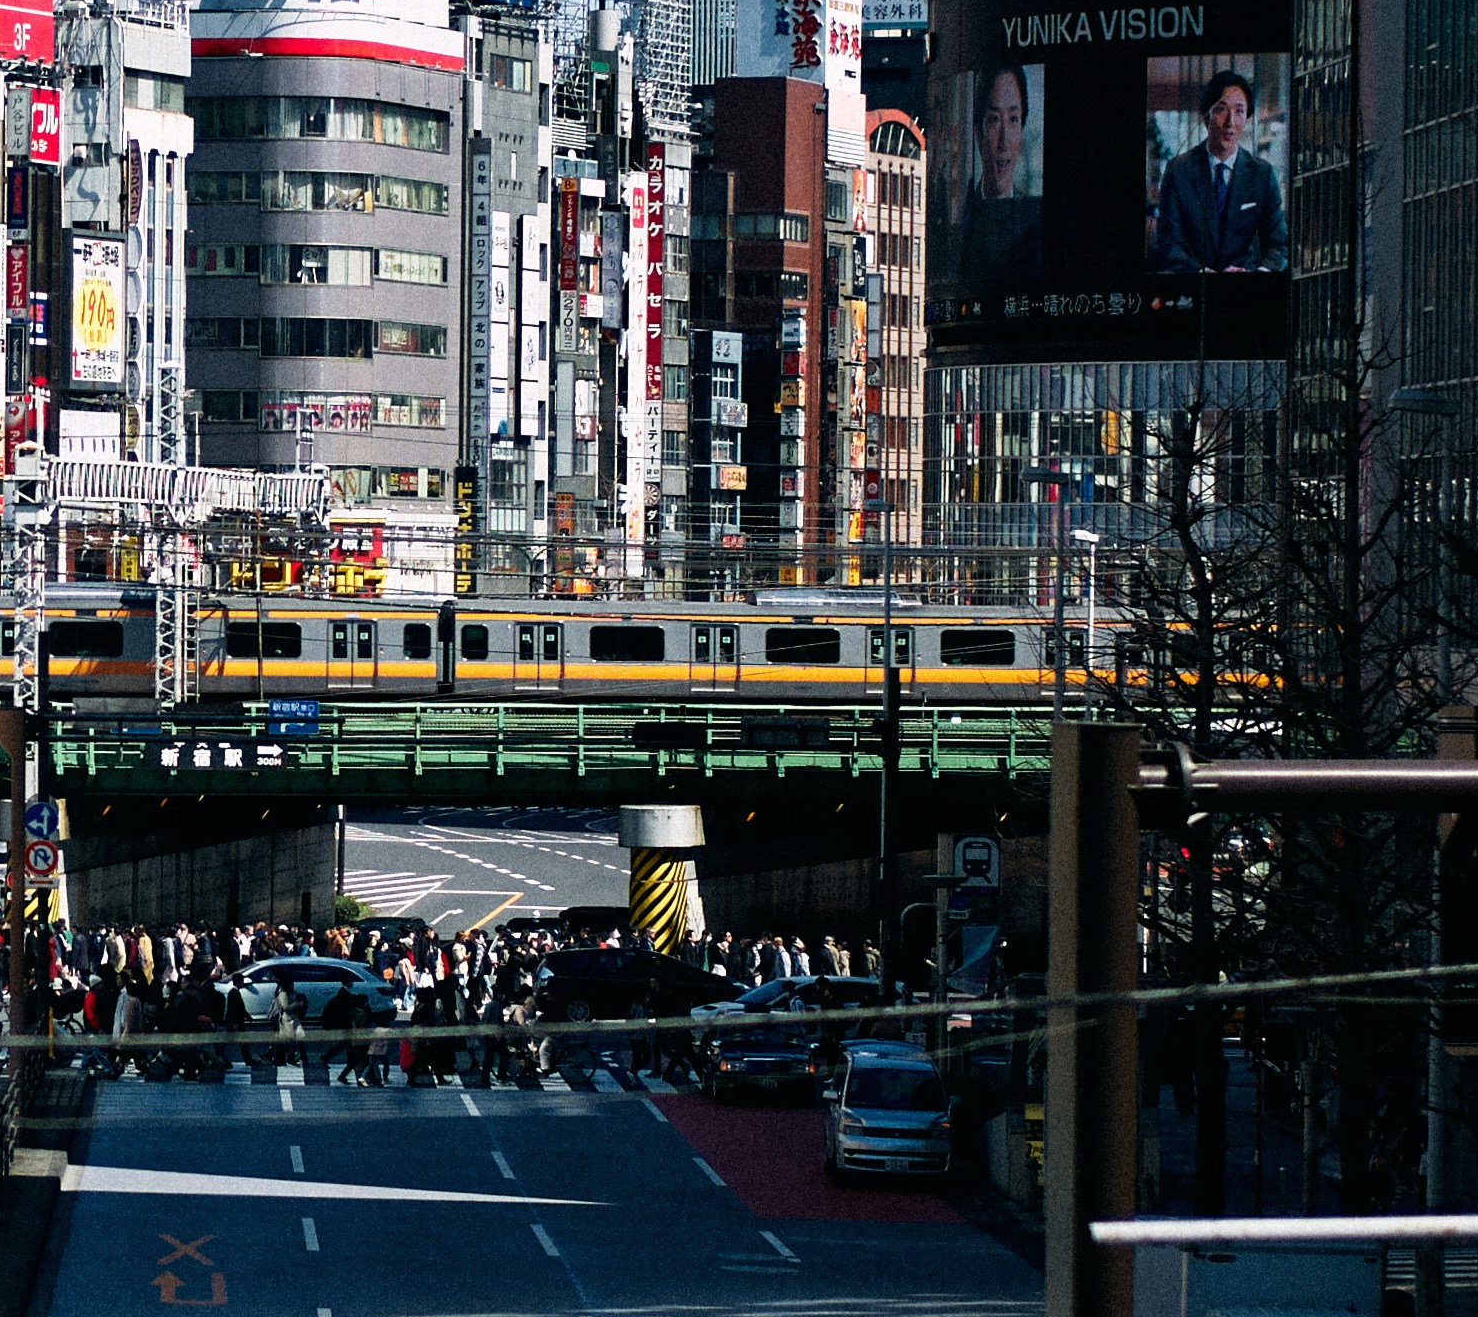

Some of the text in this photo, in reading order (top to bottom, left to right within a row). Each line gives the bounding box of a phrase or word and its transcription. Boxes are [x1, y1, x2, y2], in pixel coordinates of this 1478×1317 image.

[13, 23, 32, 52] 3F
[1001, 5, 1204, 49] YUNIKA VISION
[9, 95, 26, 152] 戸谷ビル
[474, 238, 488, 311] ロックアップ
[646, 154, 663, 340] カラオケ パセラ
[11, 260, 23, 307] アイフル
[473, 322, 488, 392] 北の家族
[647, 406, 659, 464] パーティー
[160, 746, 282, 768] 新宿駅 300M
